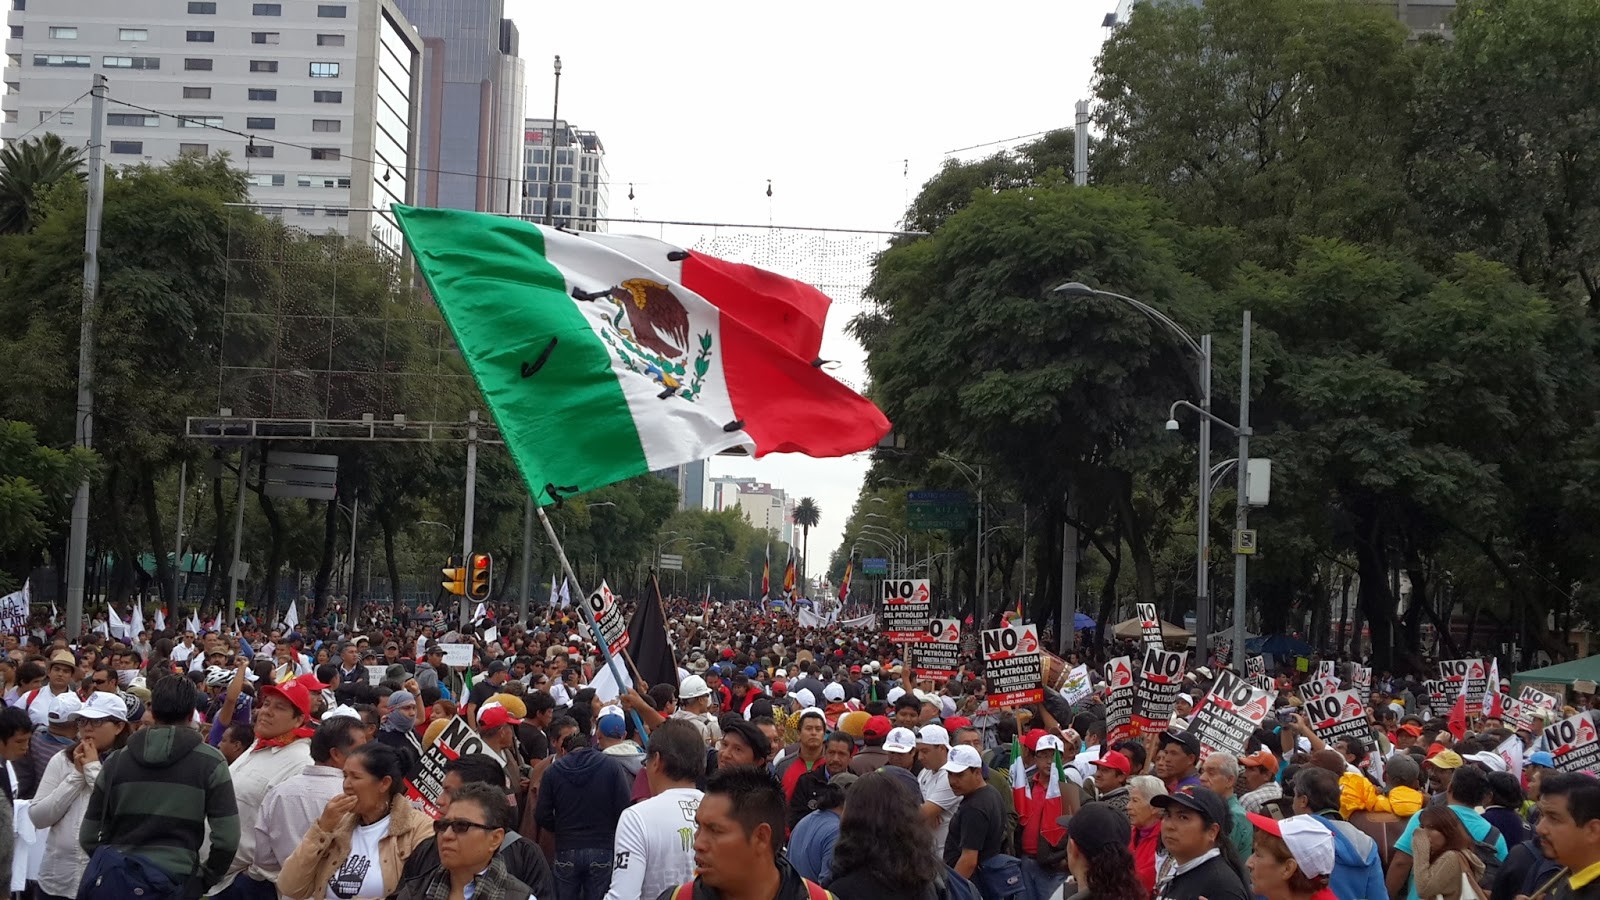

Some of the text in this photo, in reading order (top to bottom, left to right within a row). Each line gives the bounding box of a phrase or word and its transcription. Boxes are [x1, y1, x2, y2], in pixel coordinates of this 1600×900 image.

[884, 581, 914, 598] NO
[1138, 604, 1155, 621] NO
[983, 629, 1017, 653] NO
[1005, 656, 1039, 666] ENTREGA
[1144, 649, 1180, 677] NO
[1441, 661, 1467, 676] NO
[987, 670, 999, 678] DEL
[1000, 666, 1033, 676] PETRÓLEO
[1000, 676, 1019, 684] INDUSTRIA
[1020, 673, 1040, 682] ELÉCTRICA
[1002, 683, 1035, 692] EXTRANJERO
[1149, 682, 1159, 692] LA
[1214, 671, 1253, 706] NO
[1258, 676, 1269, 691] NO
[1301, 681, 1324, 700] NO
[1429, 682, 1445, 693] NO
[1137, 689, 1150, 700] DEL
[1522, 688, 1544, 703] NO
[1142, 700, 1148, 708] LA
[1306, 696, 1342, 723] NO
[1197, 711, 1211, 722] DEL
[1211, 718, 1243, 739] PETRÓLEO
[1211, 706, 1222, 716] LA
[1222, 711, 1255, 734] ENTREGA
[1333, 720, 1367, 734] ENTREGA
[440, 718, 482, 755] NO
[1198, 723, 1242, 750] LA INDUSTRIA ELÉCTRICA
[1545, 721, 1575, 750] NO
[428, 747, 448, 767] A LA
[1560, 756, 1568, 765] LA
[1569, 743, 1599, 760] ENTREGA
[421, 756, 434, 771] DEL
[1567, 754, 1596, 771] PETRÓLEO
[418, 769, 426, 779] LA
[412, 779, 420, 787] AL
[425, 804, 437, 816] MÁS
